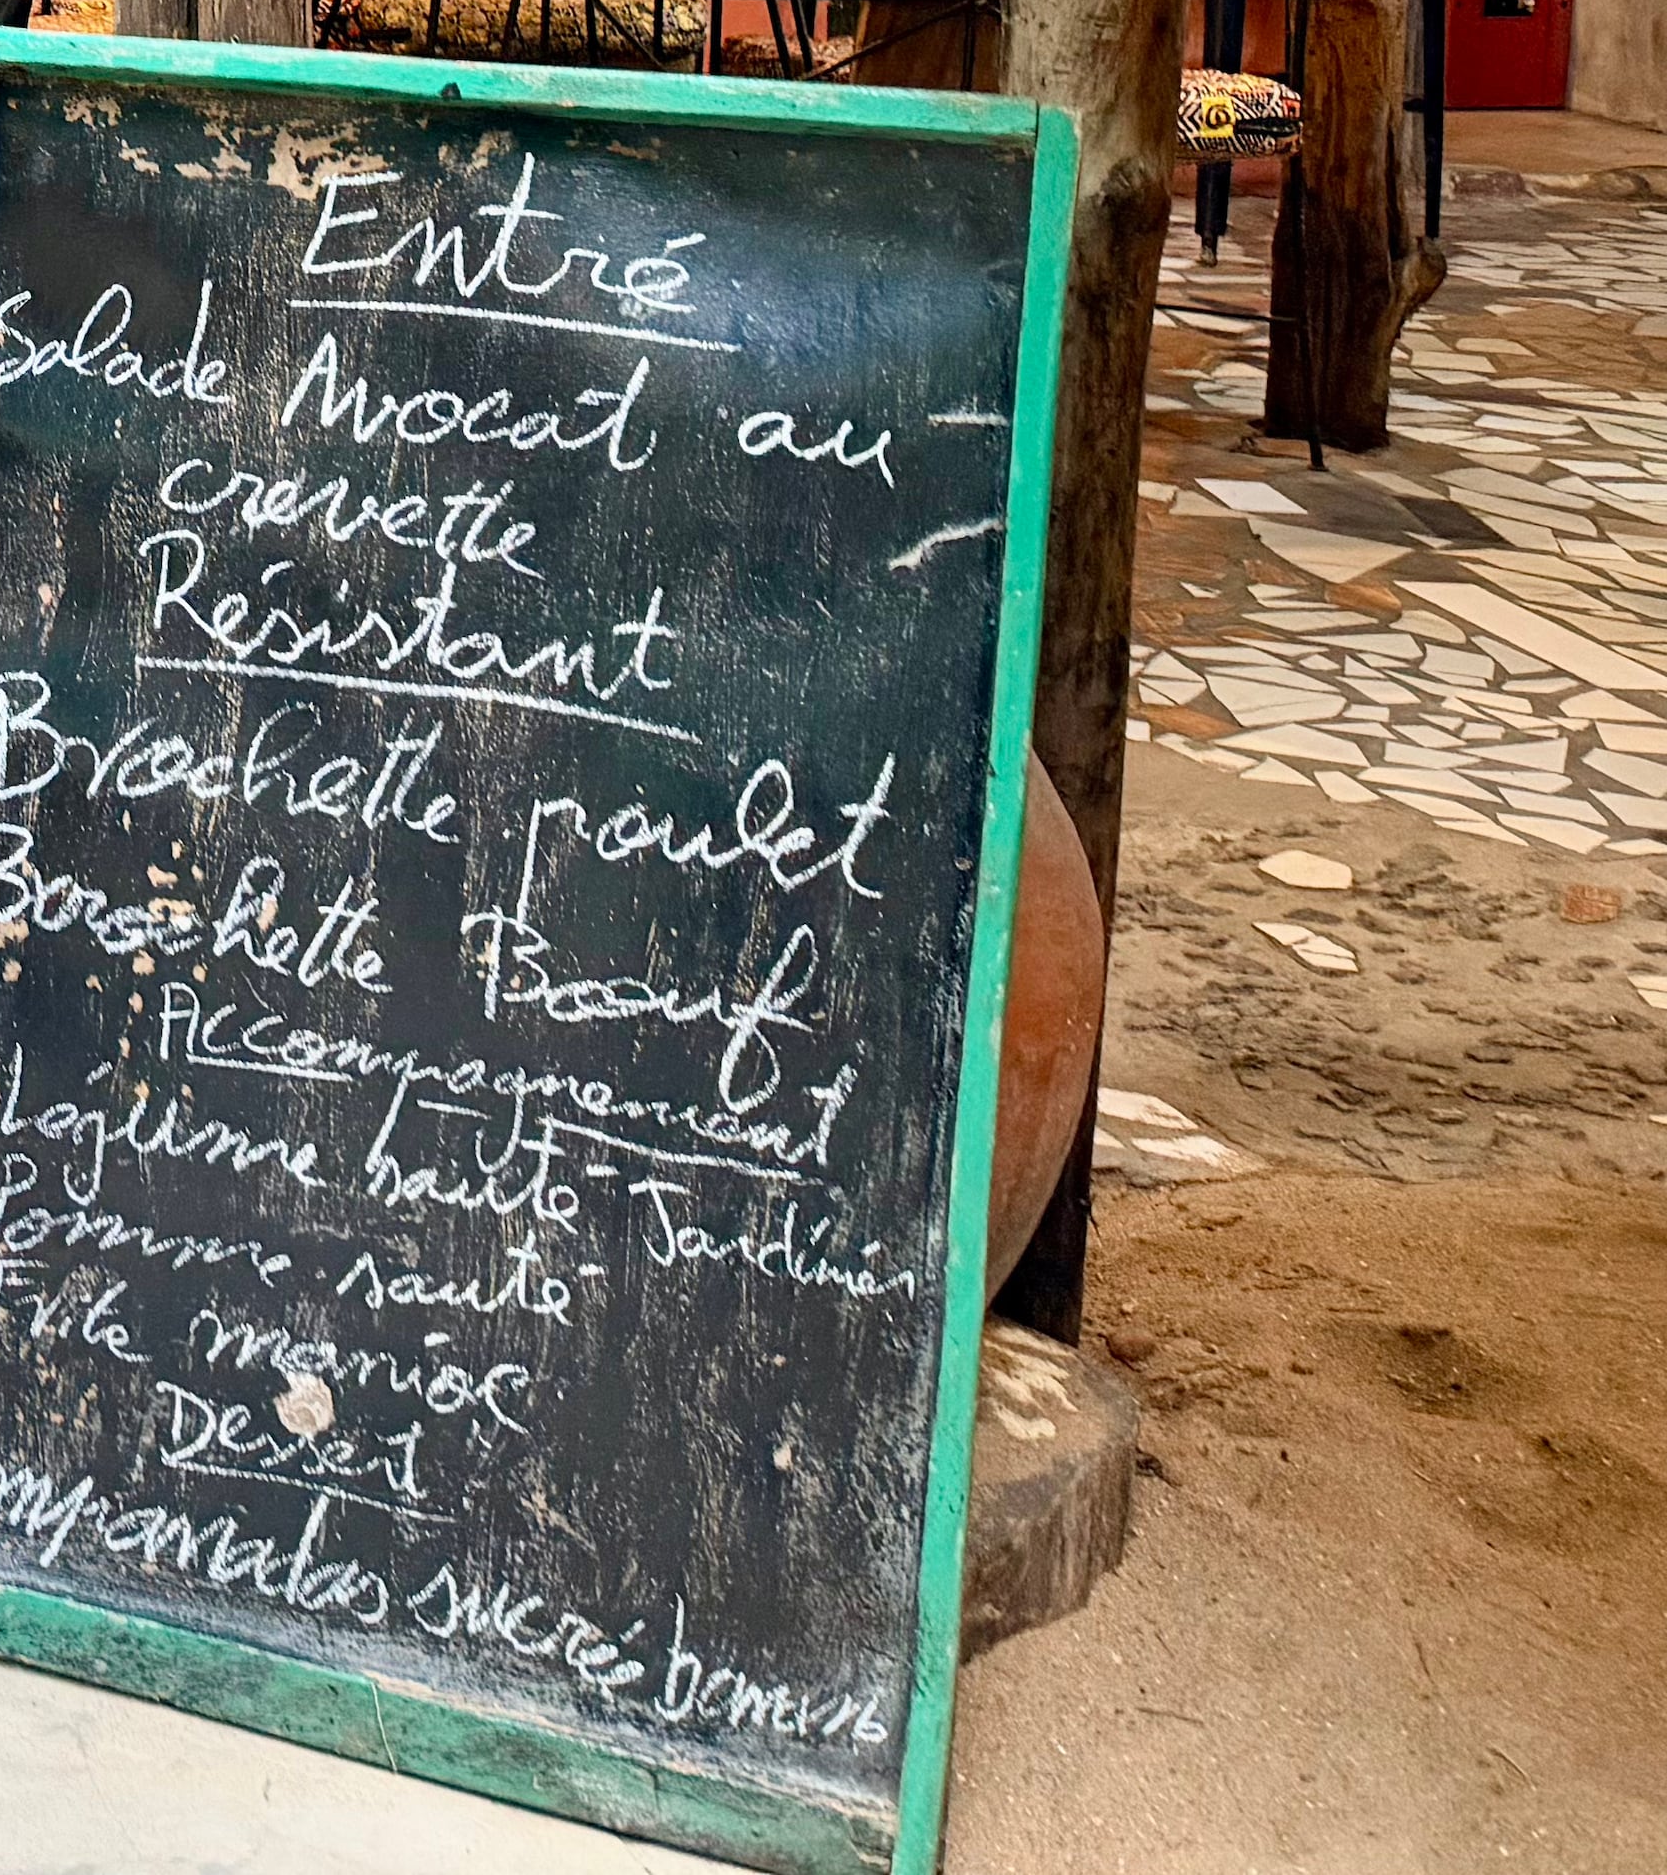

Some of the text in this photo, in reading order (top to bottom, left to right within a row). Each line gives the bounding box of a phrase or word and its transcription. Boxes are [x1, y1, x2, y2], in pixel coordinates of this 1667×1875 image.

[281, 332, 657, 472] Avocat
[738, 410, 895, 489] au
[516, 751, 896, 928] poulet
